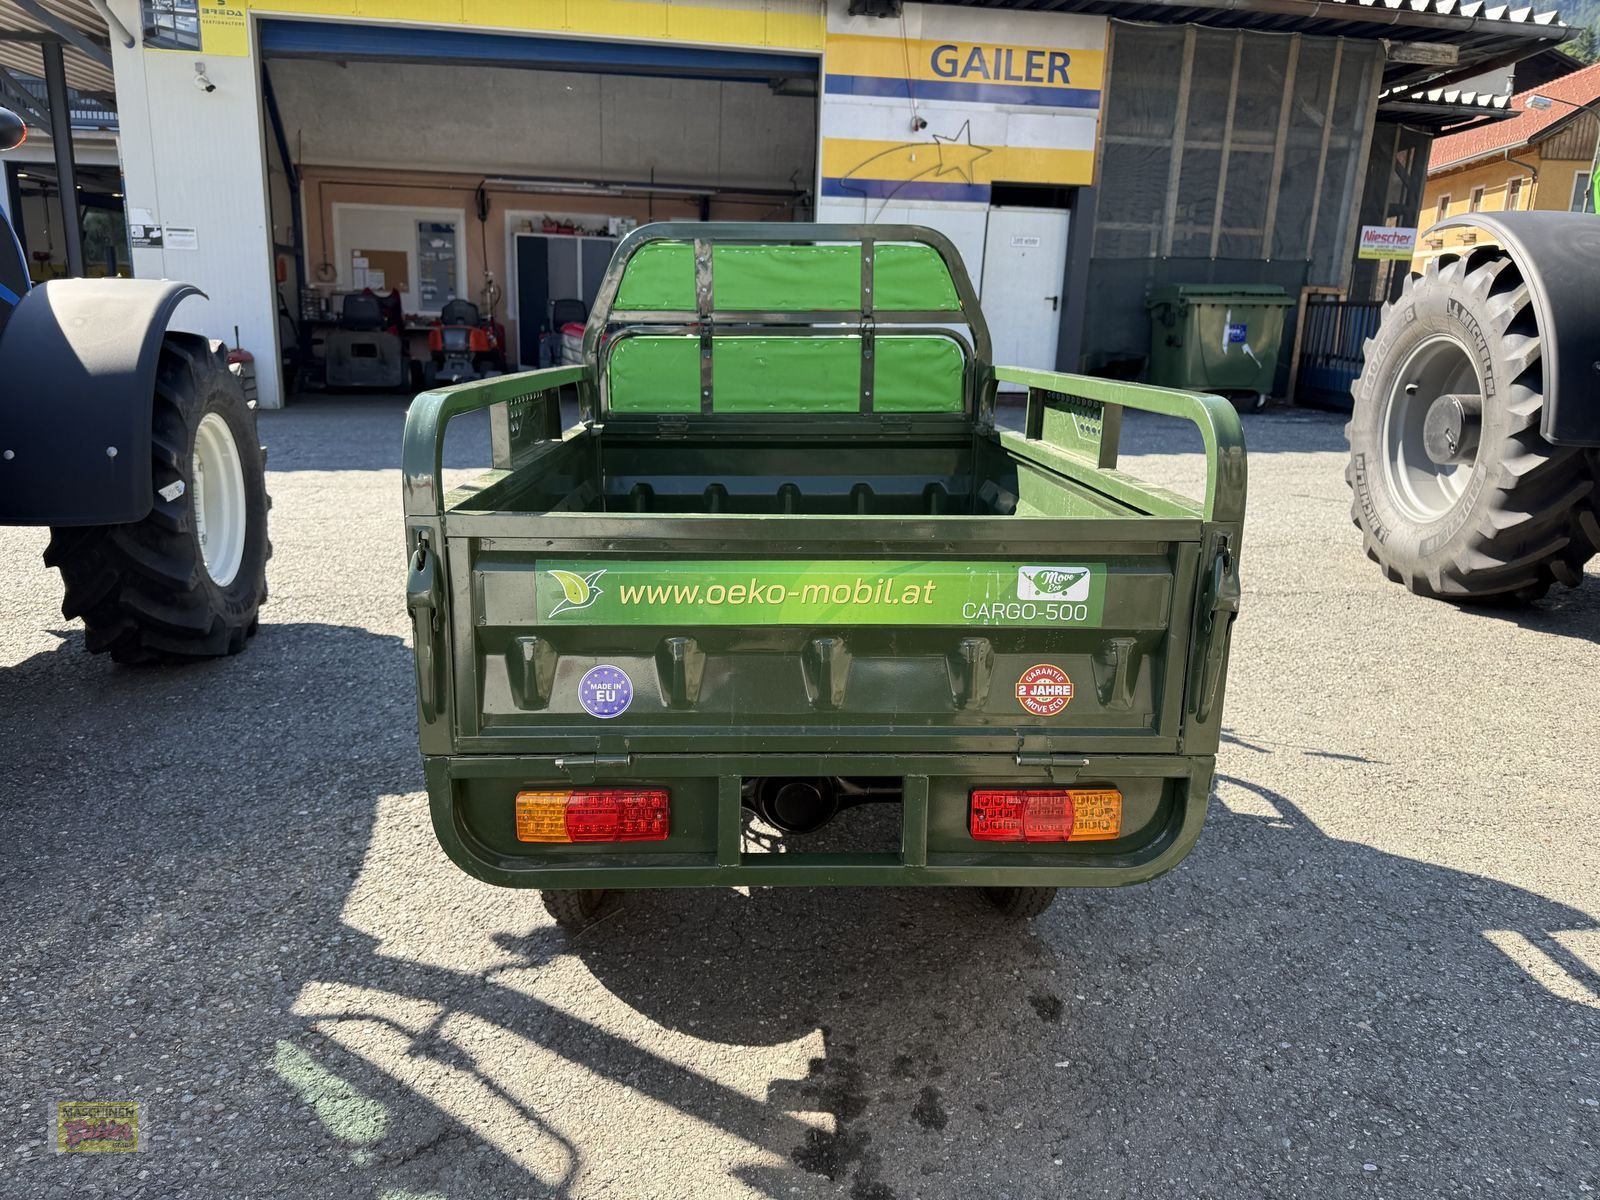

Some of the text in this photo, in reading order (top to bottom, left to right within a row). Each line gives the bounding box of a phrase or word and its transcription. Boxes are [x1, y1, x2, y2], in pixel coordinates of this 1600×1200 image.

[930, 44, 1071, 84] GAILER
[1363, 229, 1411, 244] Niescher
[1041, 571, 1074, 584] Move
[619, 578, 936, 605] www.oeko-mobil.at
[1047, 583, 1062, 592] Eco
[962, 602, 1088, 621] CARGO-500
[1025, 667, 1064, 682] GARANTIE
[596, 690, 616, 702] EU
[1018, 685, 1071, 696] 2 JAHRE
[1025, 698, 1064, 713] MOVE ECO
